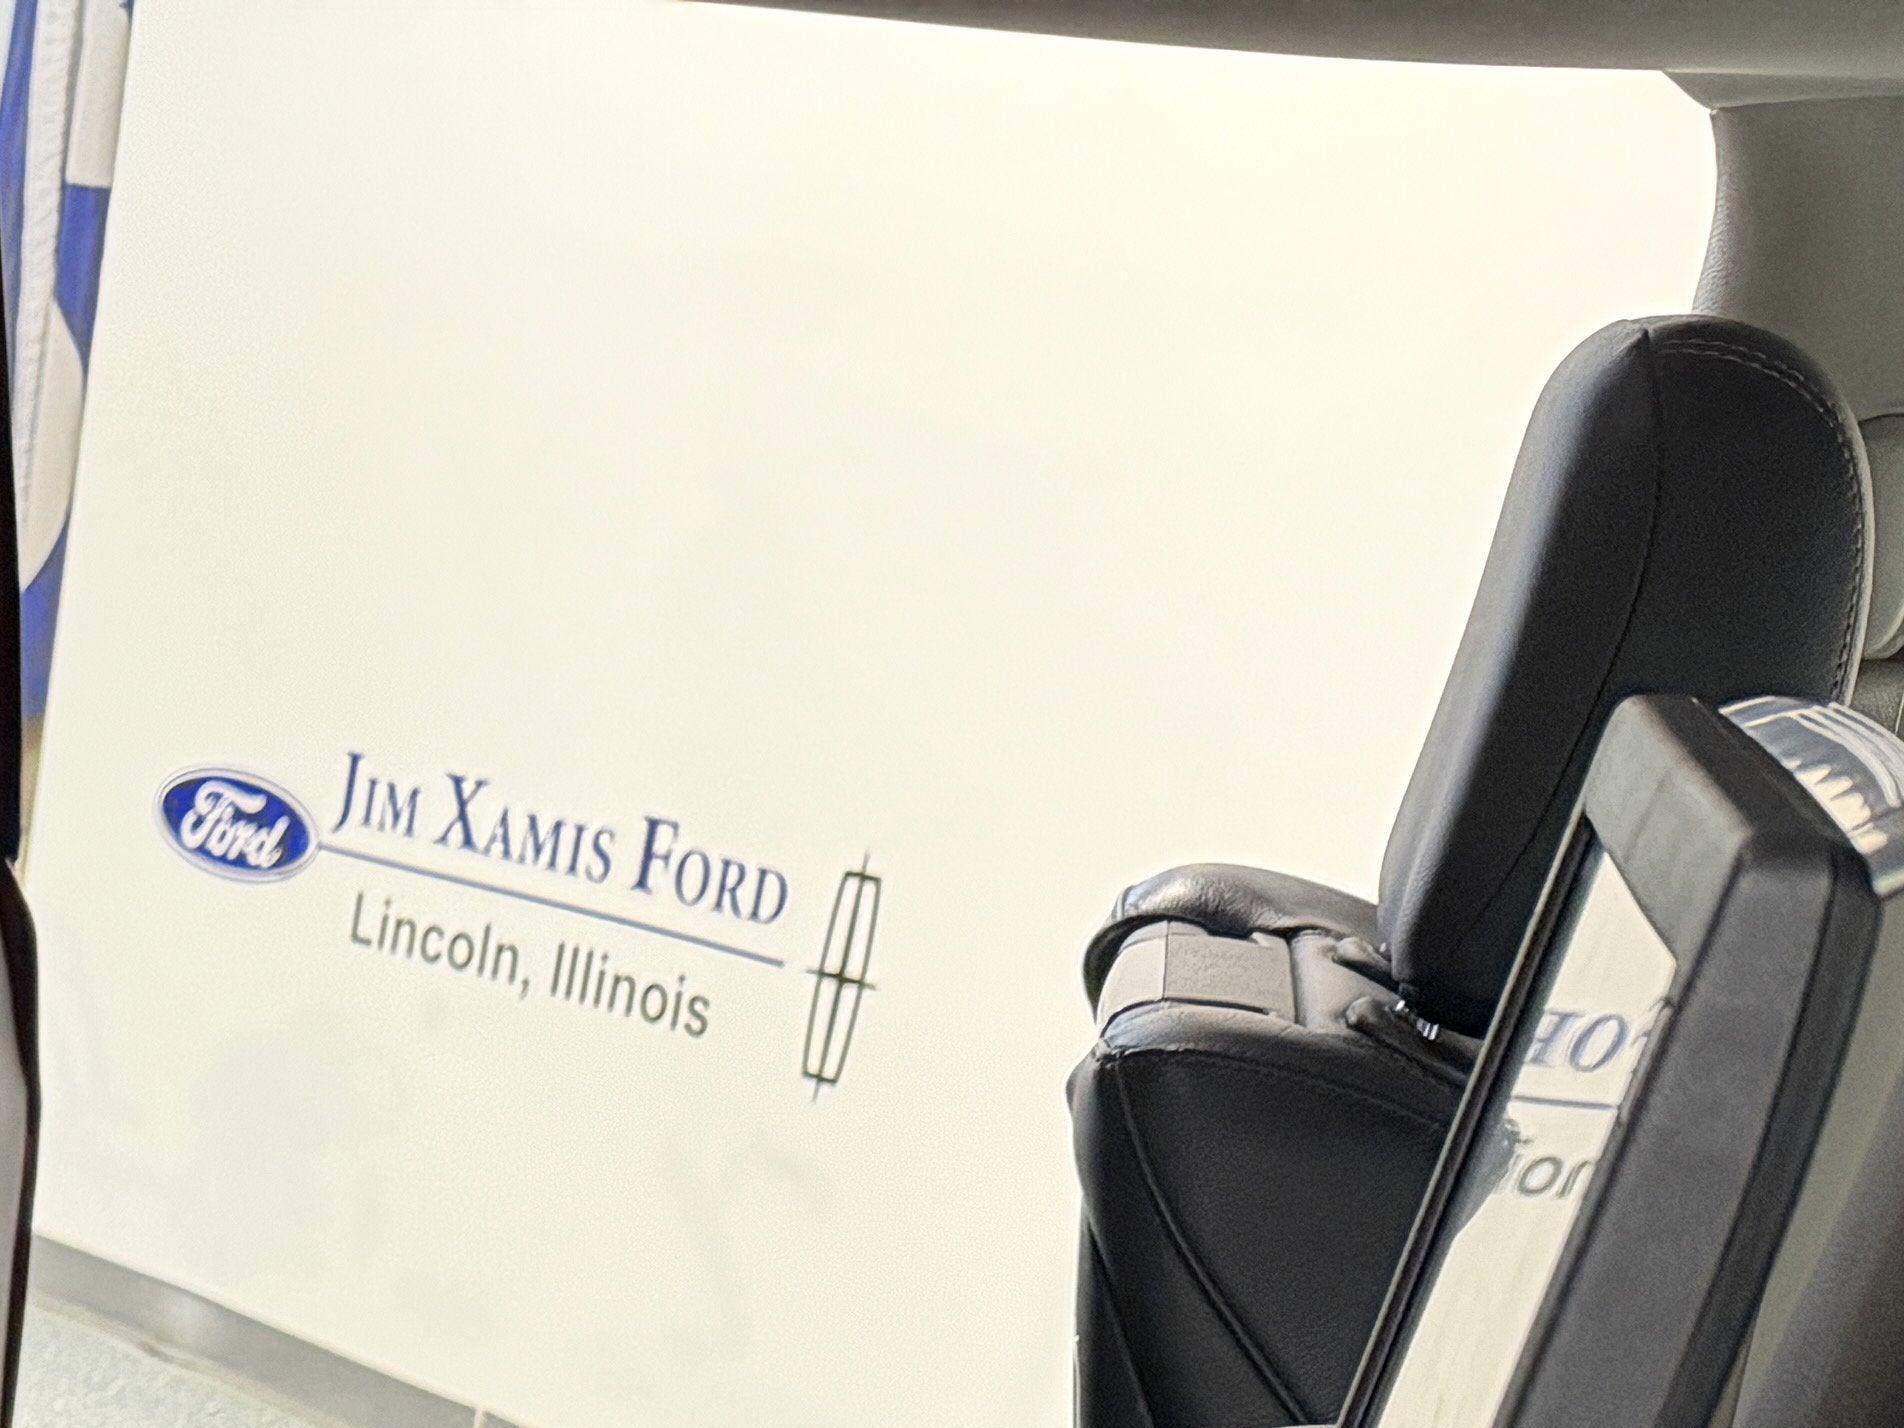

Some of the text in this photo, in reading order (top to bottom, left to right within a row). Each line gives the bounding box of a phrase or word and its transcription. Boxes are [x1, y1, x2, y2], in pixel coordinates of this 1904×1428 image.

[182, 778, 287, 870] Ford
[350, 892, 711, 1039] Lincoln, Illinois
